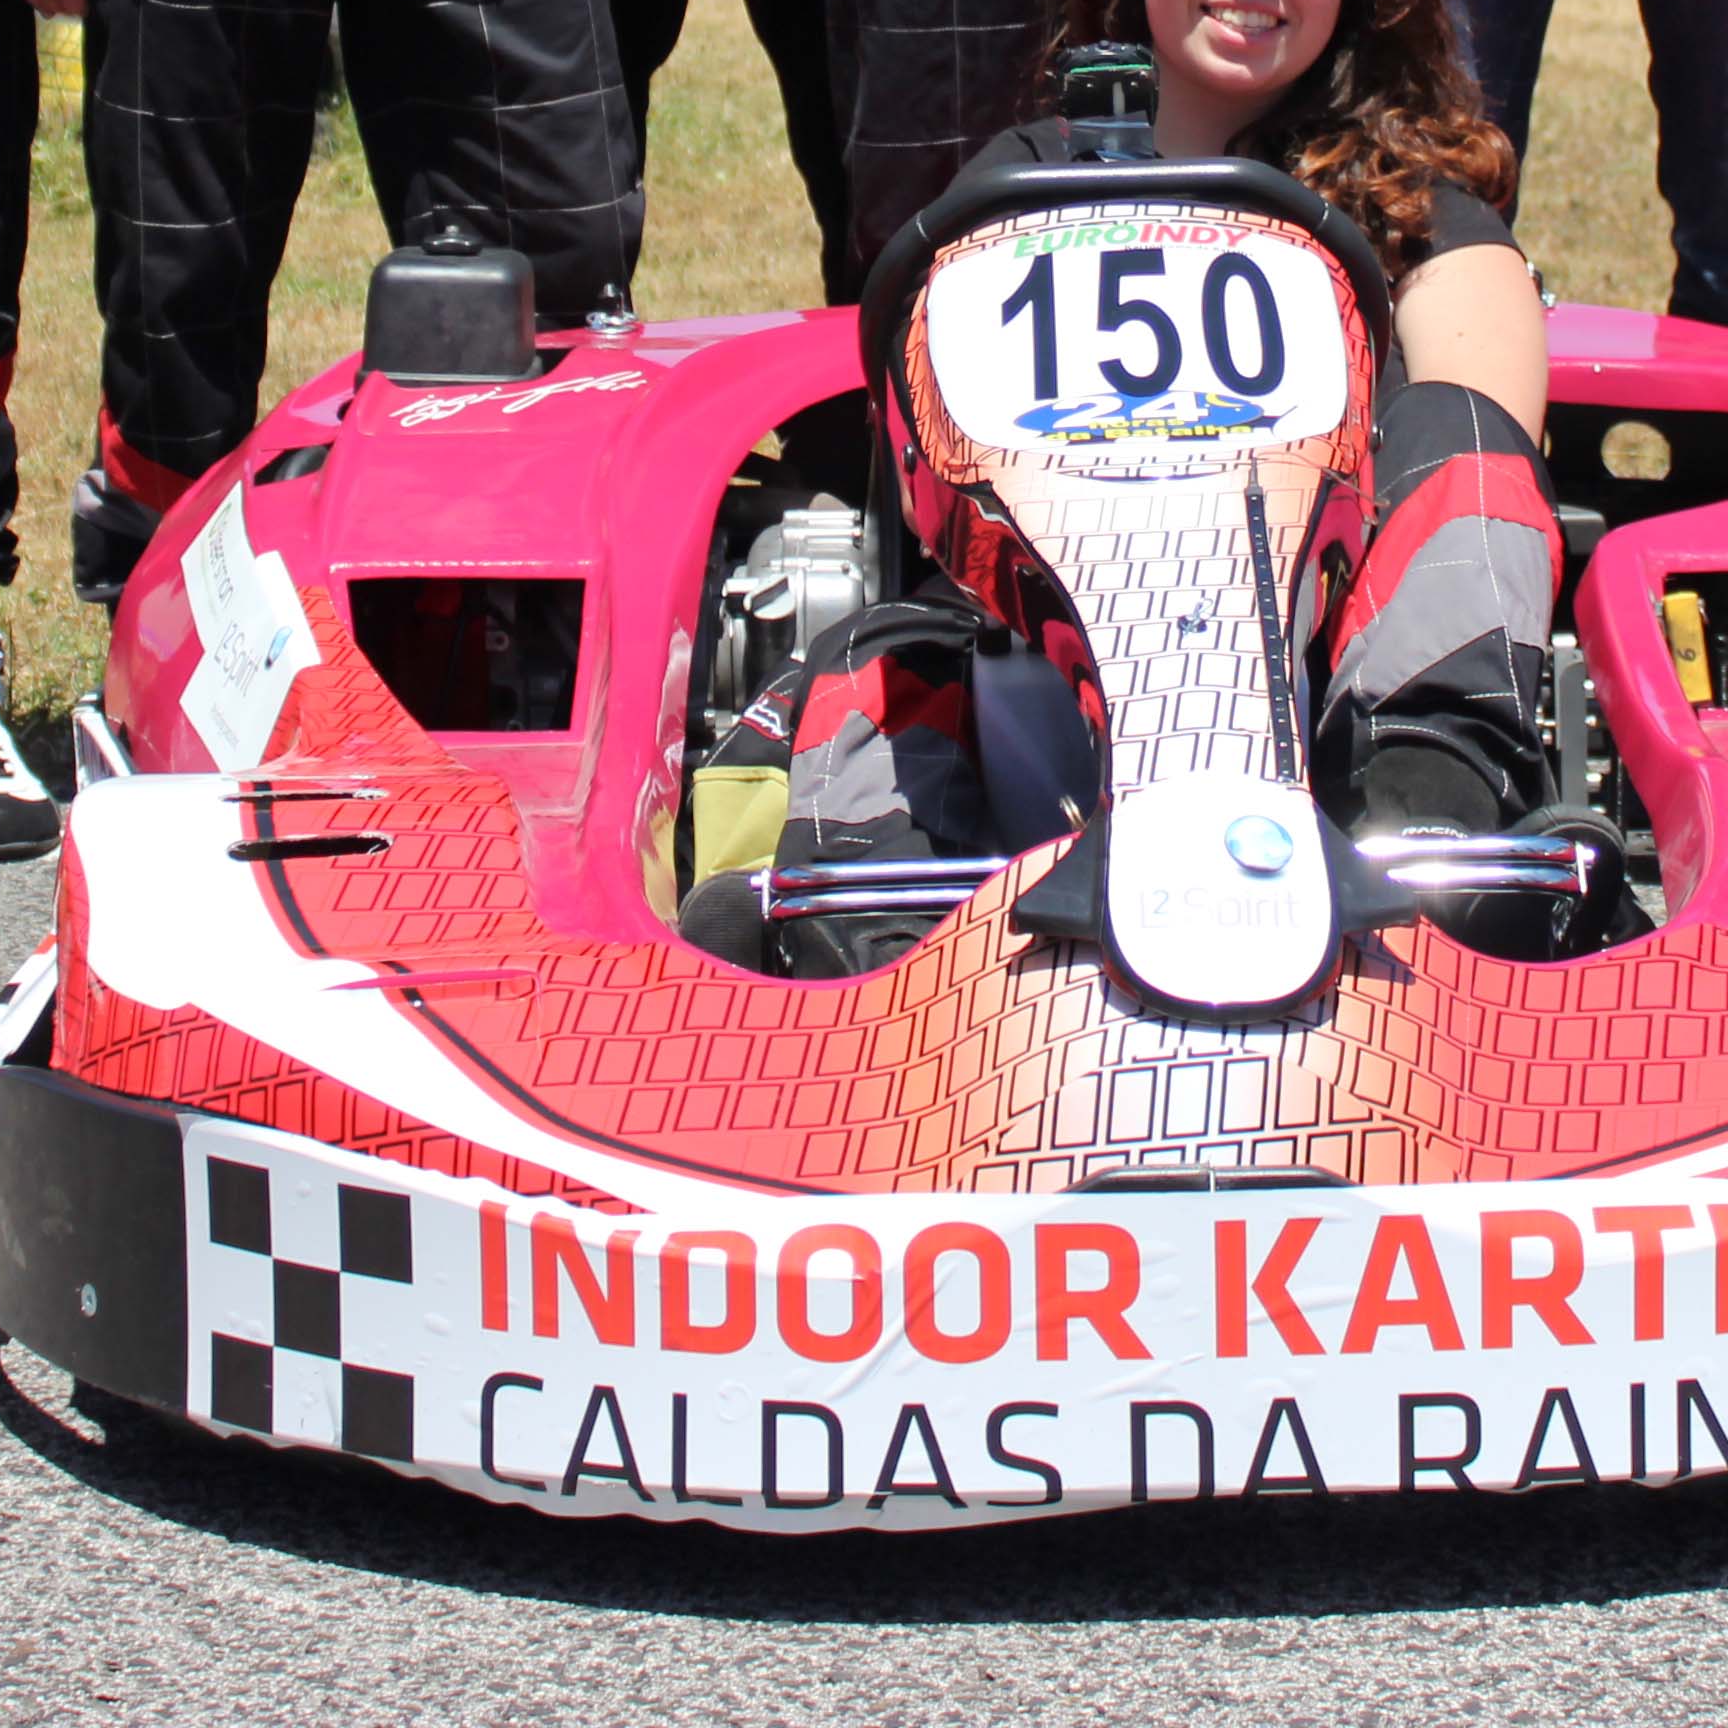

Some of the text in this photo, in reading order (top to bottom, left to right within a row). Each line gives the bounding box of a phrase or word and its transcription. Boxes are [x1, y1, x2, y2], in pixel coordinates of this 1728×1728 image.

[1013, 222, 1252, 259] EUROINDY
[1001, 248, 1285, 401] 150
[1104, 425, 1253, 440] Batalha
[480, 1200, 1152, 1363] INDOOR
[480, 1373, 1064, 1510] CALDAS
[1130, 1398, 1323, 1503] DA
